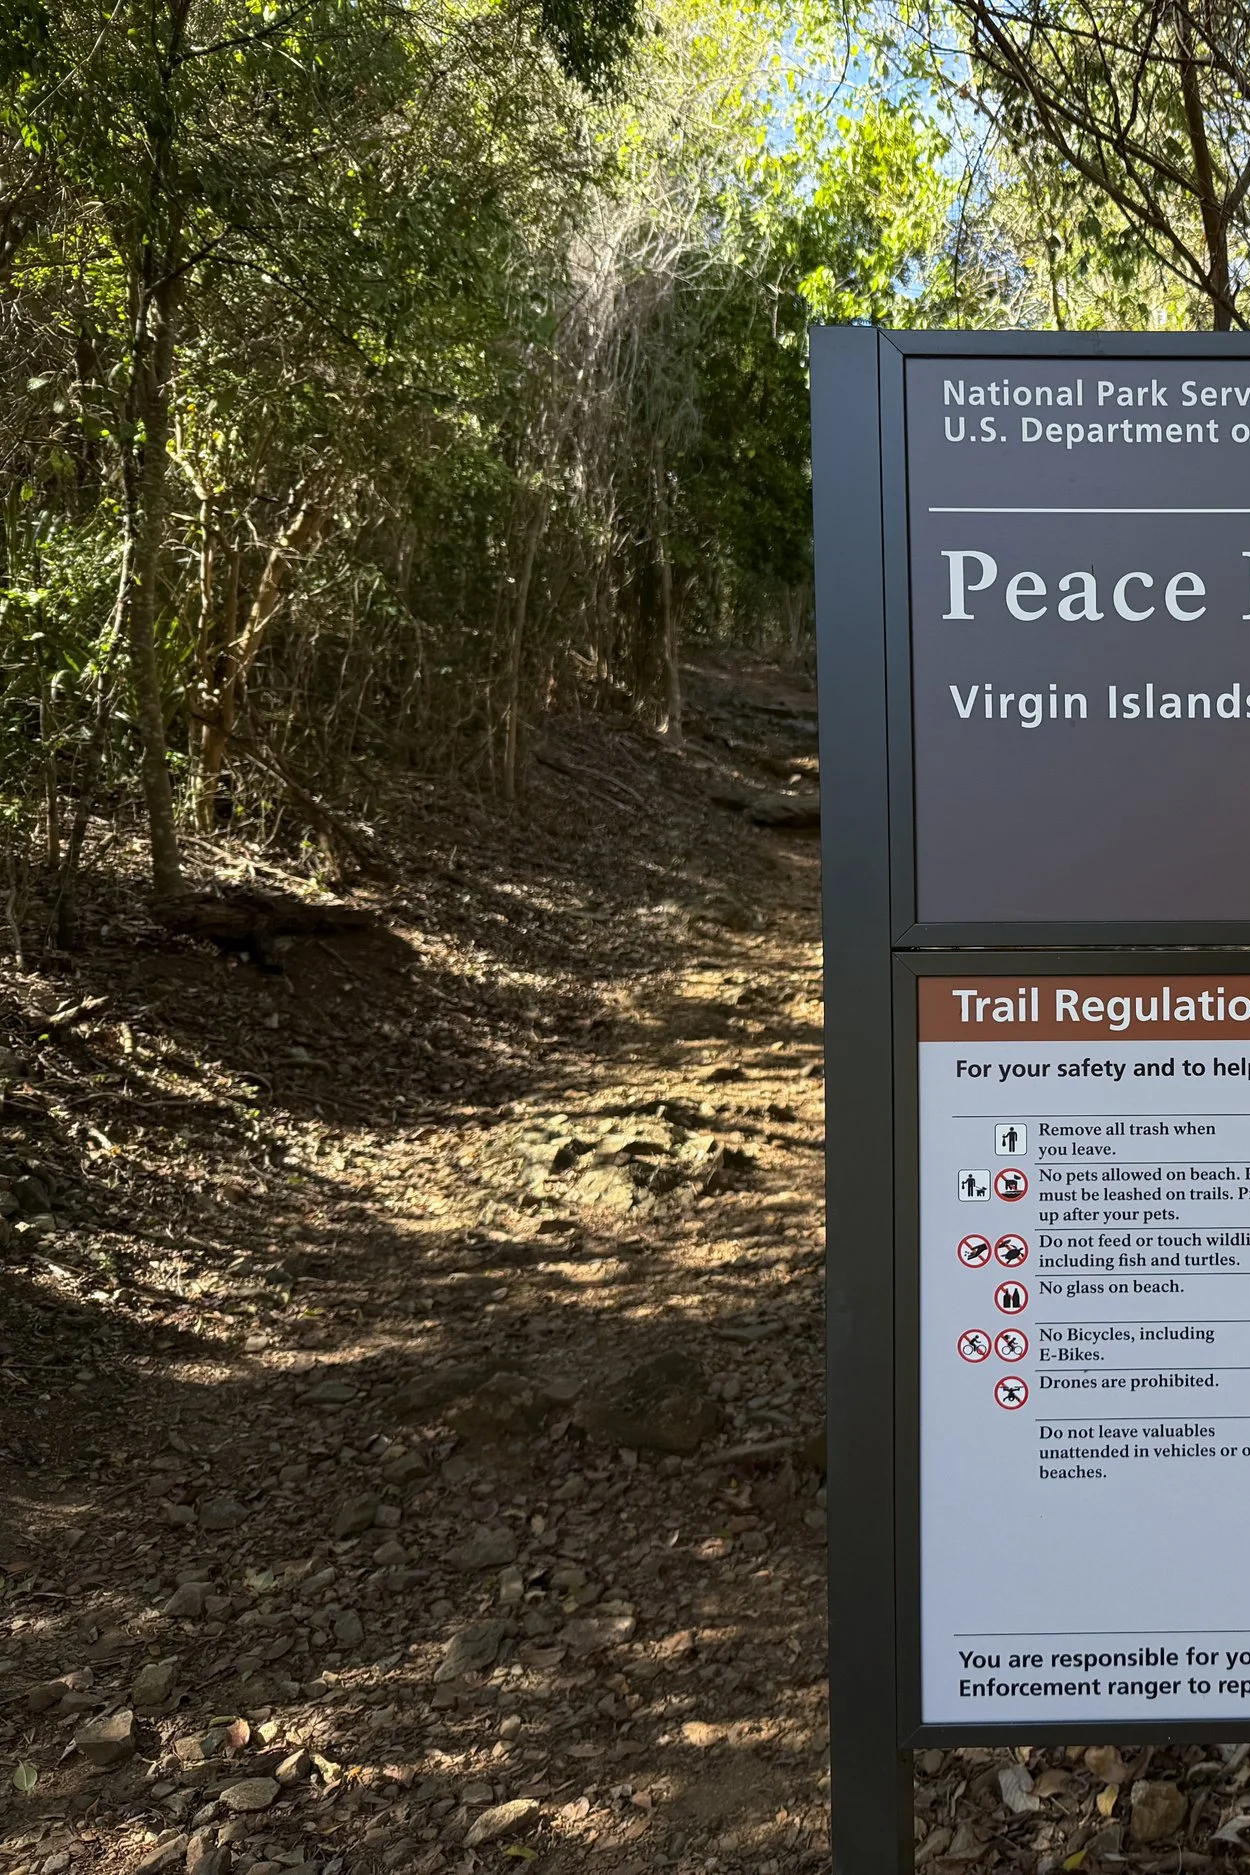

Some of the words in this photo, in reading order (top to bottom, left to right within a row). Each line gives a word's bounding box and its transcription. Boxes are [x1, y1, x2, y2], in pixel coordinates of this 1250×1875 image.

[943, 378, 1084, 407] National
[1097, 378, 1169, 407] Park
[944, 416, 1007, 443] U.S.
[1021, 416, 1220, 450] Department
[940, 549, 1207, 622] Peace
[948, 682, 1088, 729] Virgin
[951, 986, 1039, 1023] Trail
[956, 1059, 993, 1079] For
[997, 1063, 1052, 1083] your
[1056, 1057, 1127, 1083] safety
[1132, 1056, 1175, 1078] and
[1181, 1059, 1206, 1077] to
[1038, 1122, 1102, 1137] Remove
[1105, 1121, 1126, 1137] all
[1128, 1121, 1170, 1136] trash
[1172, 1120, 1217, 1136] when
[1037, 1145, 1068, 1161] you
[1071, 1141, 1117, 1156] leave.
[1038, 1168, 1063, 1183] No
[1065, 1169, 1099, 1186] pets
[1101, 1166, 1163, 1182] allowed
[1165, 1170, 1187, 1182] on
[1189, 1166, 1241, 1181] beach.
[1038, 1189, 1078, 1202] must
[1080, 1187, 1100, 1202] be
[1103, 1186, 1162, 1202] leashed
[1165, 1190, 1186, 1201] on
[1189, 1185, 1234, 1201] trails.
[1038, 1211, 1060, 1226] up
[1062, 1206, 1100, 1222] after
[1102, 1210, 1140, 1226] your
[1142, 1208, 1180, 1225] pets.
[1038, 1234, 1064, 1249] Do
[1067, 1235, 1095, 1248] not
[1097, 1232, 1132, 1248] feed
[1135, 1236, 1154, 1248] or
[1156, 1232, 1203, 1248] touch
[1038, 1253, 1115, 1272] including
[1118, 1252, 1147, 1268] fish
[1150, 1252, 1181, 1267] and
[1184, 1251, 1241, 1267] turtles.
[1039, 1280, 1063, 1295] No
[1066, 1279, 1105, 1299] glass
[1108, 1283, 1129, 1294] on
[1132, 1278, 1185, 1294] beach.
[1039, 1327, 1063, 1342] No
[1066, 1326, 1136, 1346] Bicycles,
[1139, 1325, 1216, 1344] including
[1039, 1346, 1105, 1362] E-Bikes.
[1039, 1375, 1098, 1390] Drones
[1100, 1377, 1127, 1389] are
[1130, 1372, 1220, 1393] prohibited.
[1039, 1425, 1064, 1440] Do
[1067, 1426, 1095, 1439] not
[1098, 1424, 1139, 1439] leave
[1141, 1422, 1216, 1439] valuables
[1039, 1443, 1130, 1460] unattended
[1133, 1443, 1150, 1458] in
[1153, 1442, 1217, 1458] vehicles
[1219, 1446, 1239, 1457] or
[1039, 1464, 1107, 1480] beaches.
[958, 1650, 1001, 1670] You
[1008, 1653, 1044, 1669] are
[1051, 1646, 1179, 1673] responsible
[1185, 1645, 1220, 1666] for
[959, 1677, 1102, 1698] Enforcement
[1107, 1680, 1182, 1700] ranger
[1187, 1676, 1212, 1695] to
